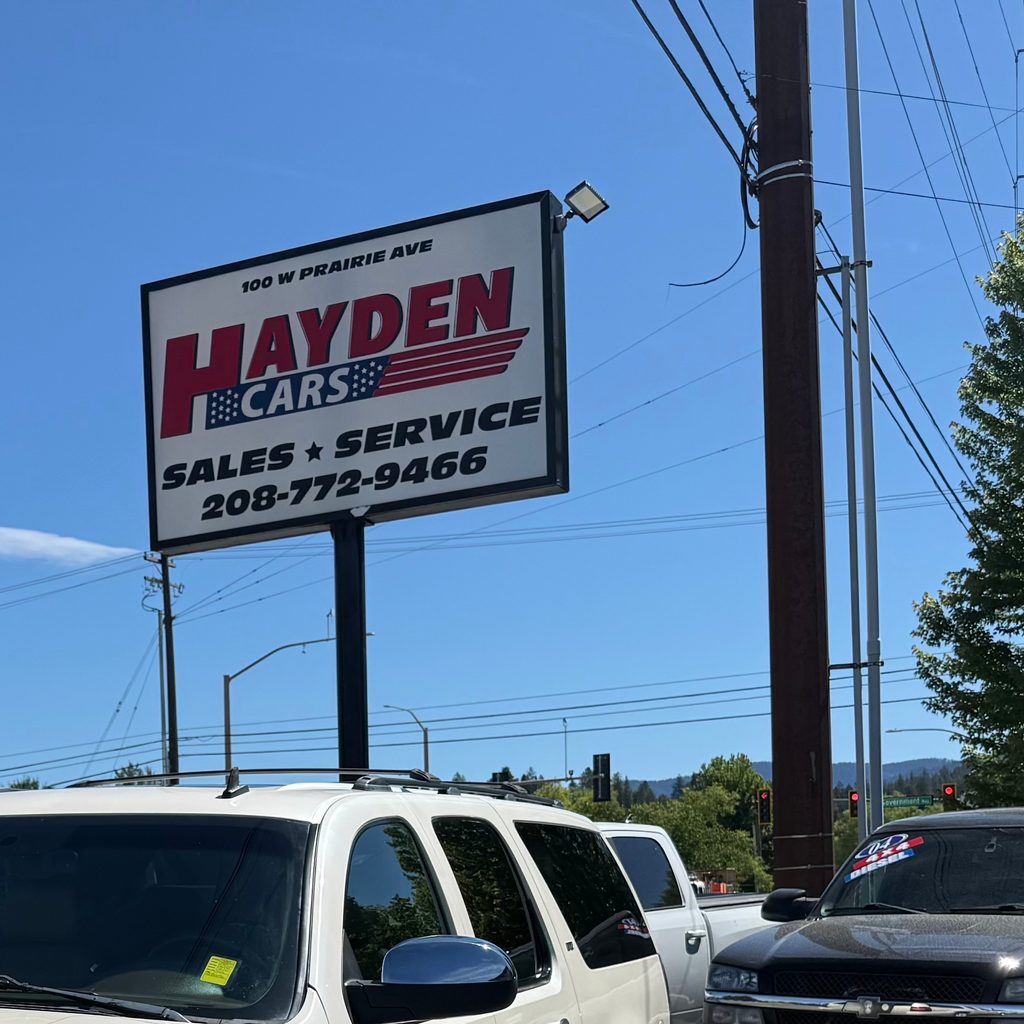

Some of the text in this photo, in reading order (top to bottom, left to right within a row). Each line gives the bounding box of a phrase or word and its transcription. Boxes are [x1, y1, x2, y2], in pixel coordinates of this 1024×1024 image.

[242, 239, 434, 293] 100 W PRAIRIE AVE
[160, 266, 515, 439] HAYDEN
[240, 367, 352, 419] CARS
[161, 395, 543, 491] SALES SERVICE
[201, 446, 489, 521] 208-772-9466
[849, 852, 910, 881] DIESEL
